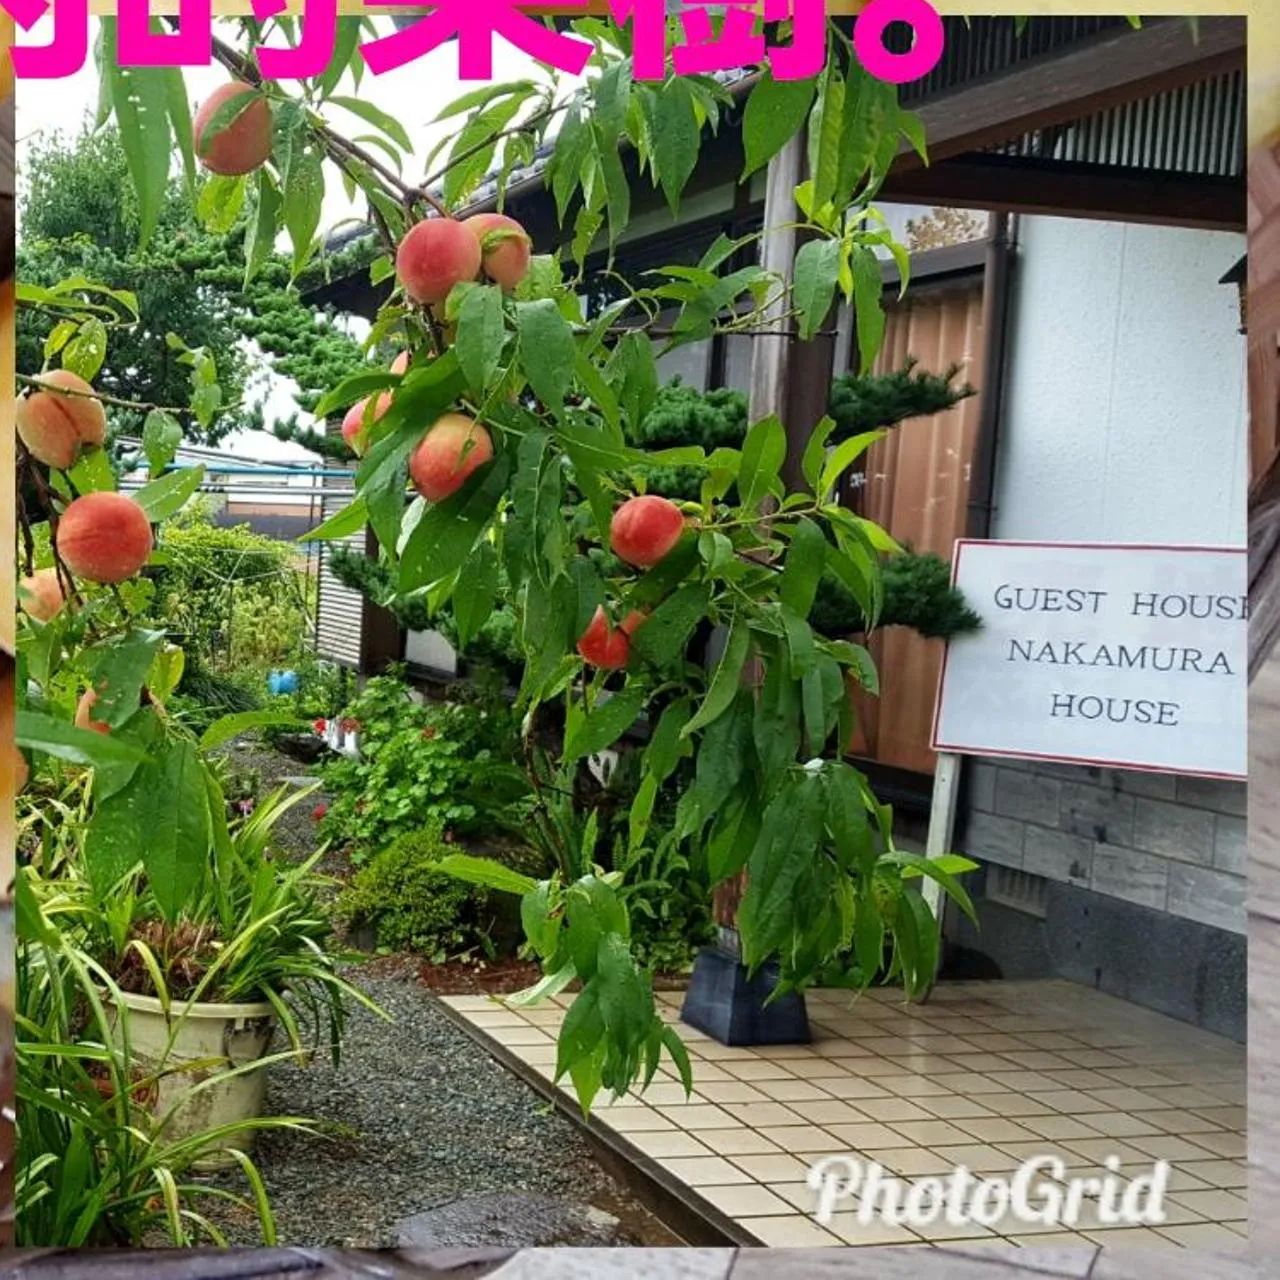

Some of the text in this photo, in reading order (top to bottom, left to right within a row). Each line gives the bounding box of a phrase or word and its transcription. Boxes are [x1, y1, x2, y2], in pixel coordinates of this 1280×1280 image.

[994, 584, 1108, 614] GUEST
[1007, 639, 1235, 675] NAKAMURA
[1049, 693, 1181, 727] HOUSE
